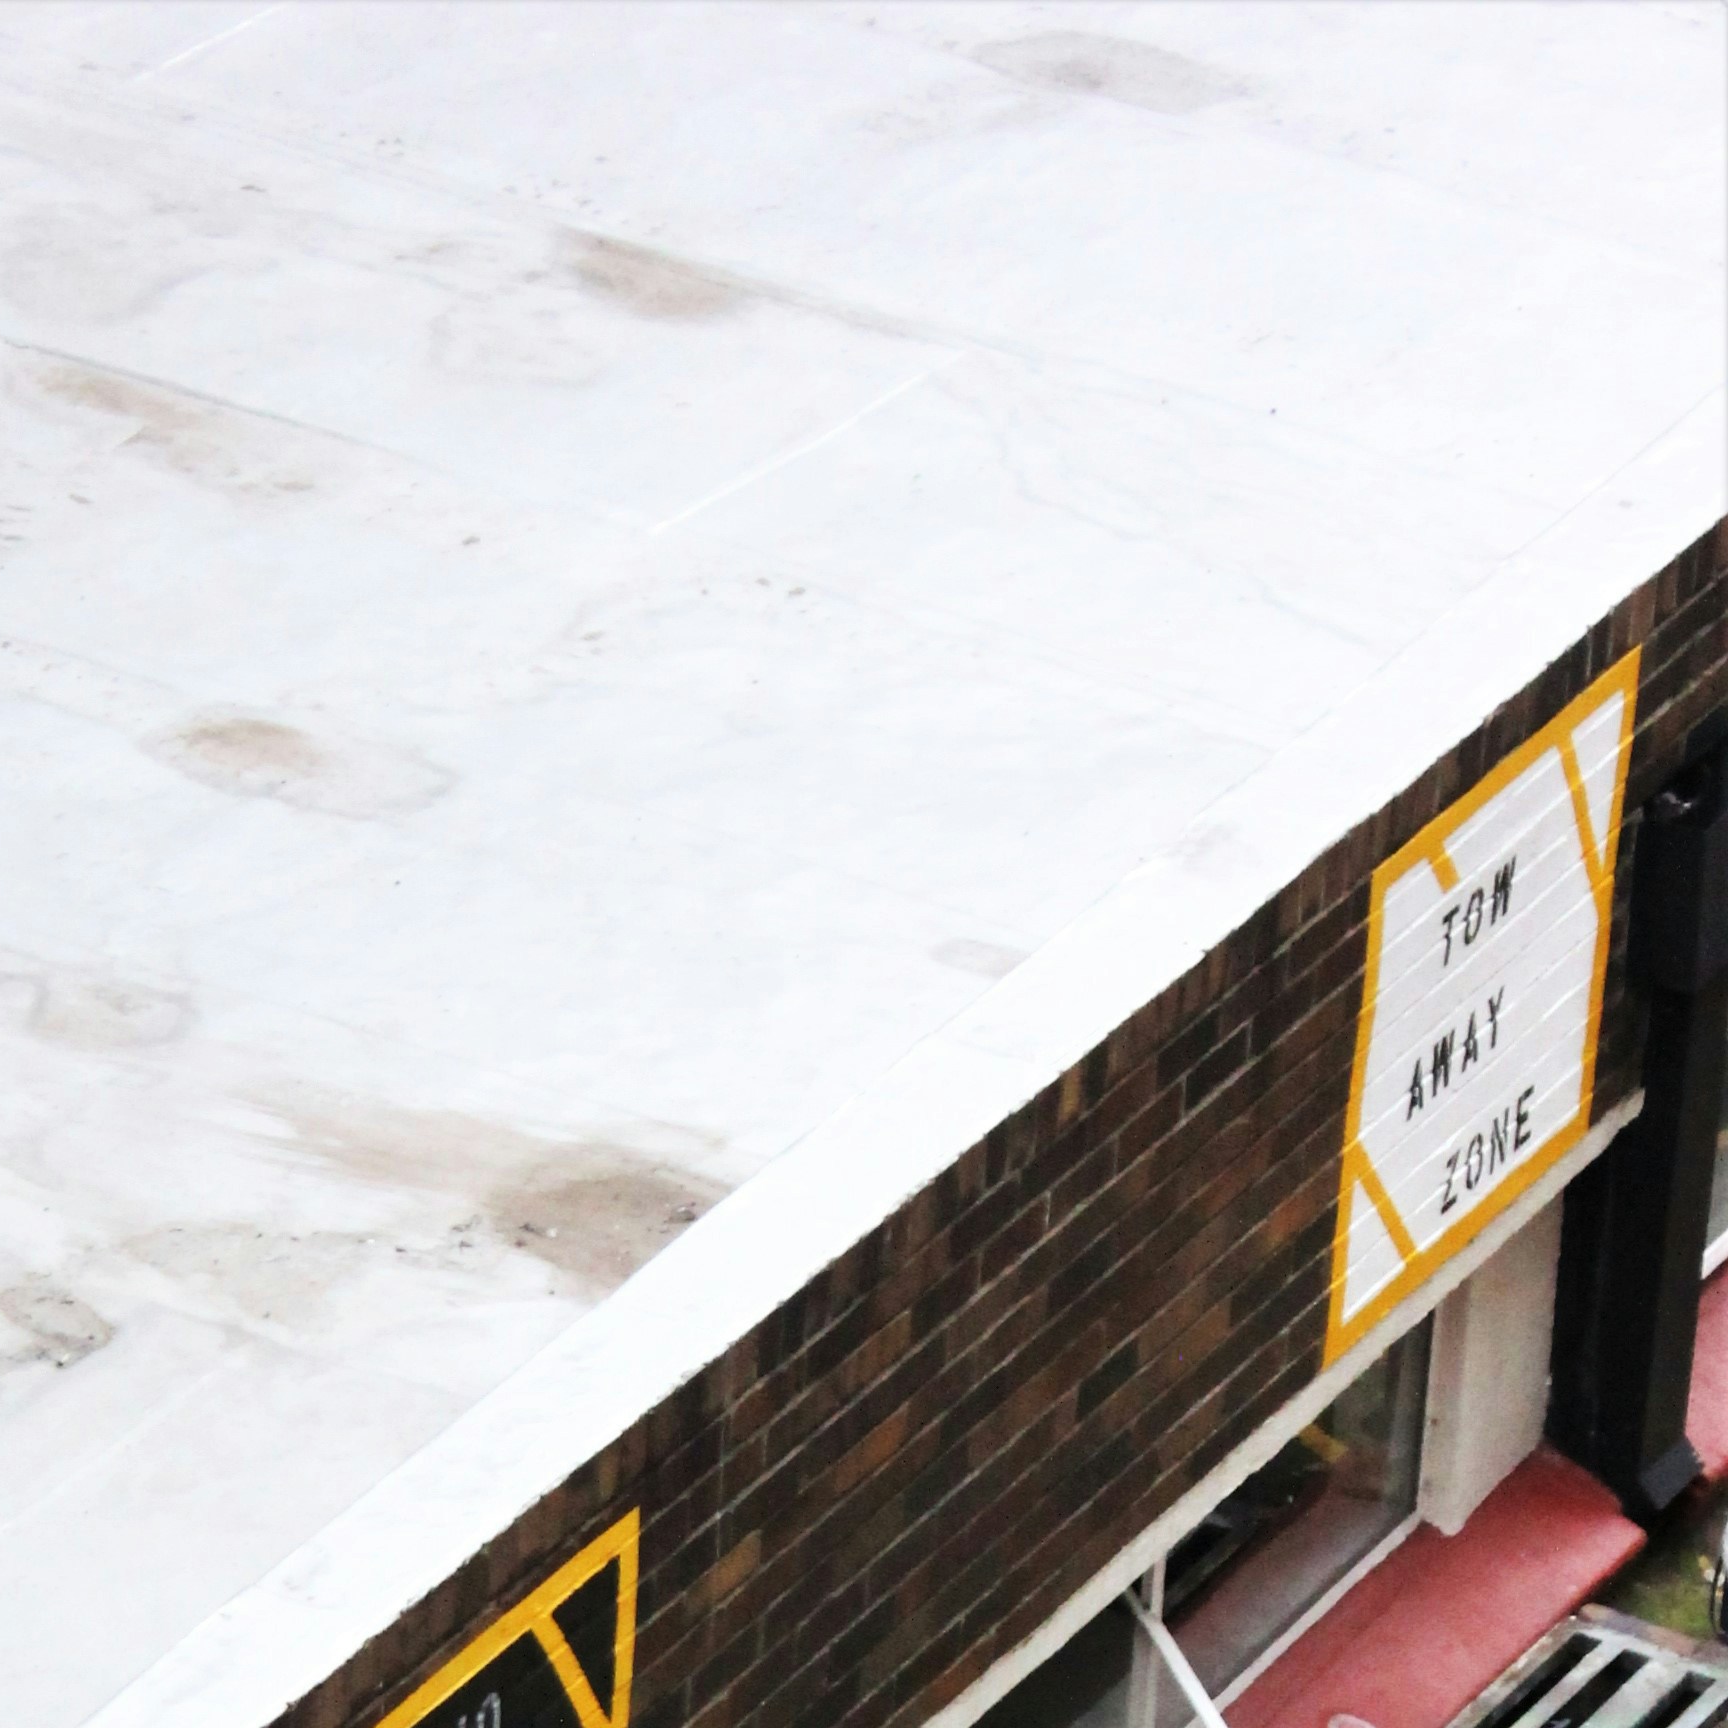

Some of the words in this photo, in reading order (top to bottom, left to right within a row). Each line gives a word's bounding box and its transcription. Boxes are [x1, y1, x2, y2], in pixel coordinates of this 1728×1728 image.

[1441, 855, 1517, 966] TOW
[1406, 986, 1504, 1121] AWAY
[1440, 1085, 1535, 1214] ZONE
